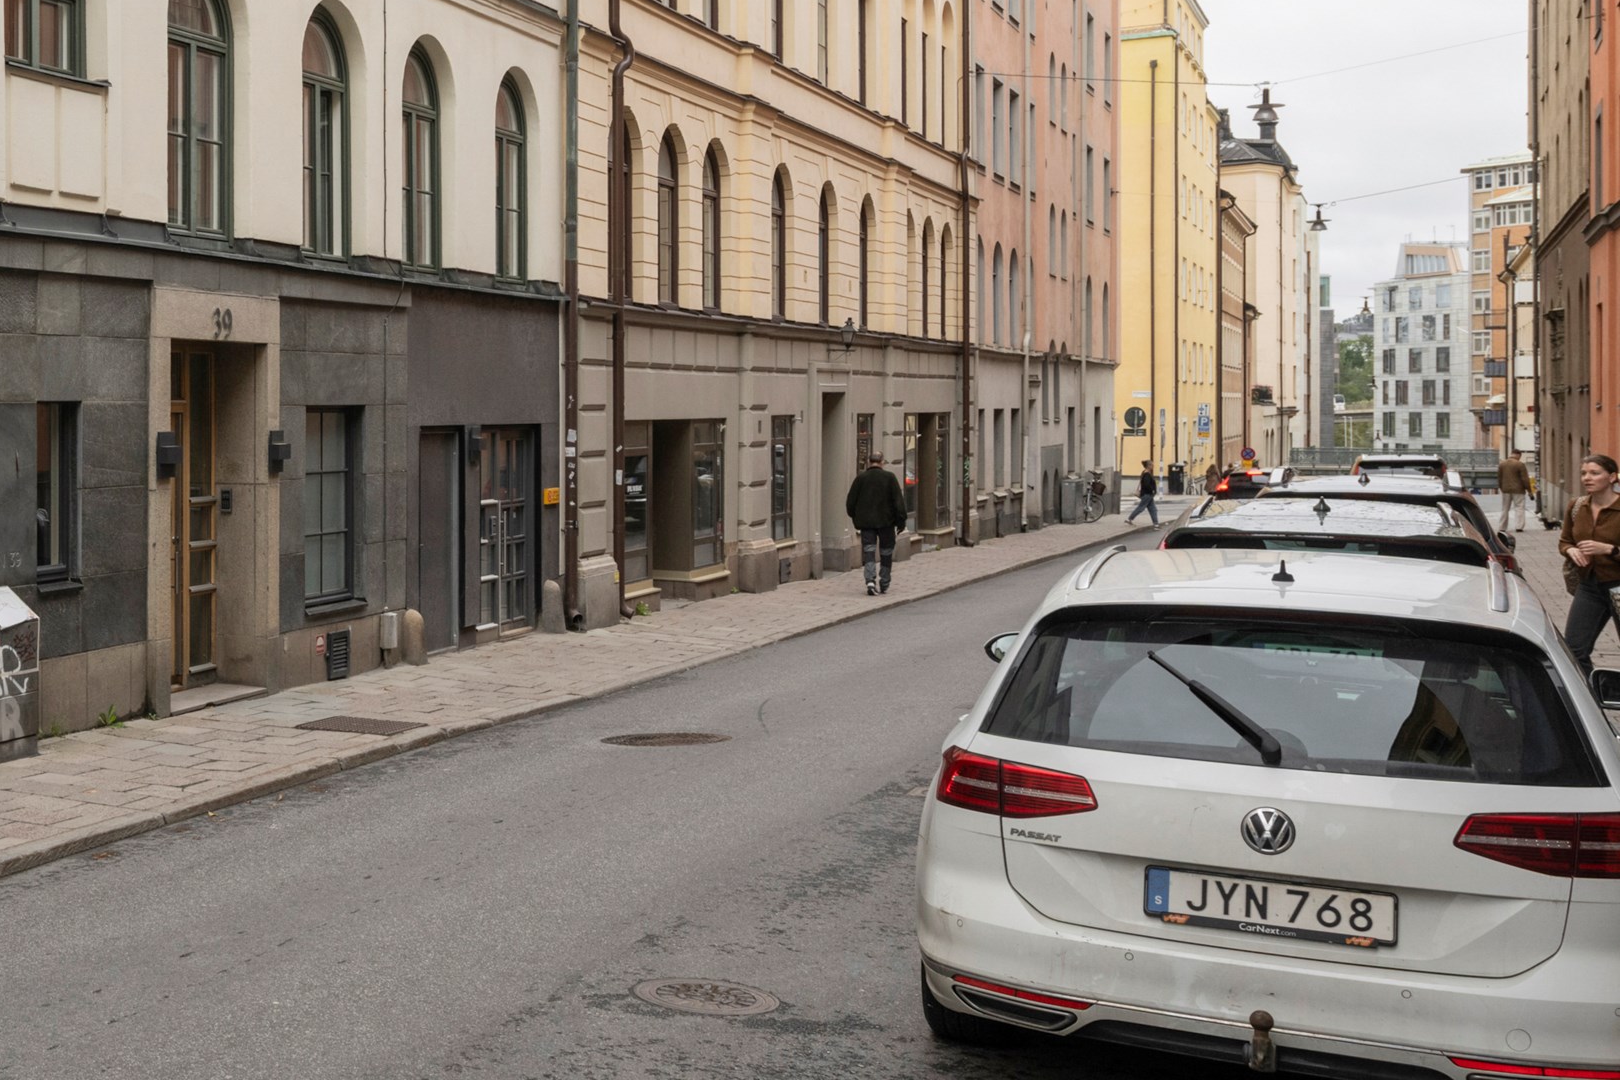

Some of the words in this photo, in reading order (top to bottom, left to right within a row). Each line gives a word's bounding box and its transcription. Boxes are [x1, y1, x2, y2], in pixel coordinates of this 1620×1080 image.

[212, 307, 233, 340] 39
[9, 552, 21, 568] 39
[1010, 827, 1062, 842] PASSAT
[1154, 895, 1163, 905] S
[1186, 879, 1269, 921] JYN
[1285, 888, 1374, 932] 768
[1238, 922, 1297, 937] CarNext.com
